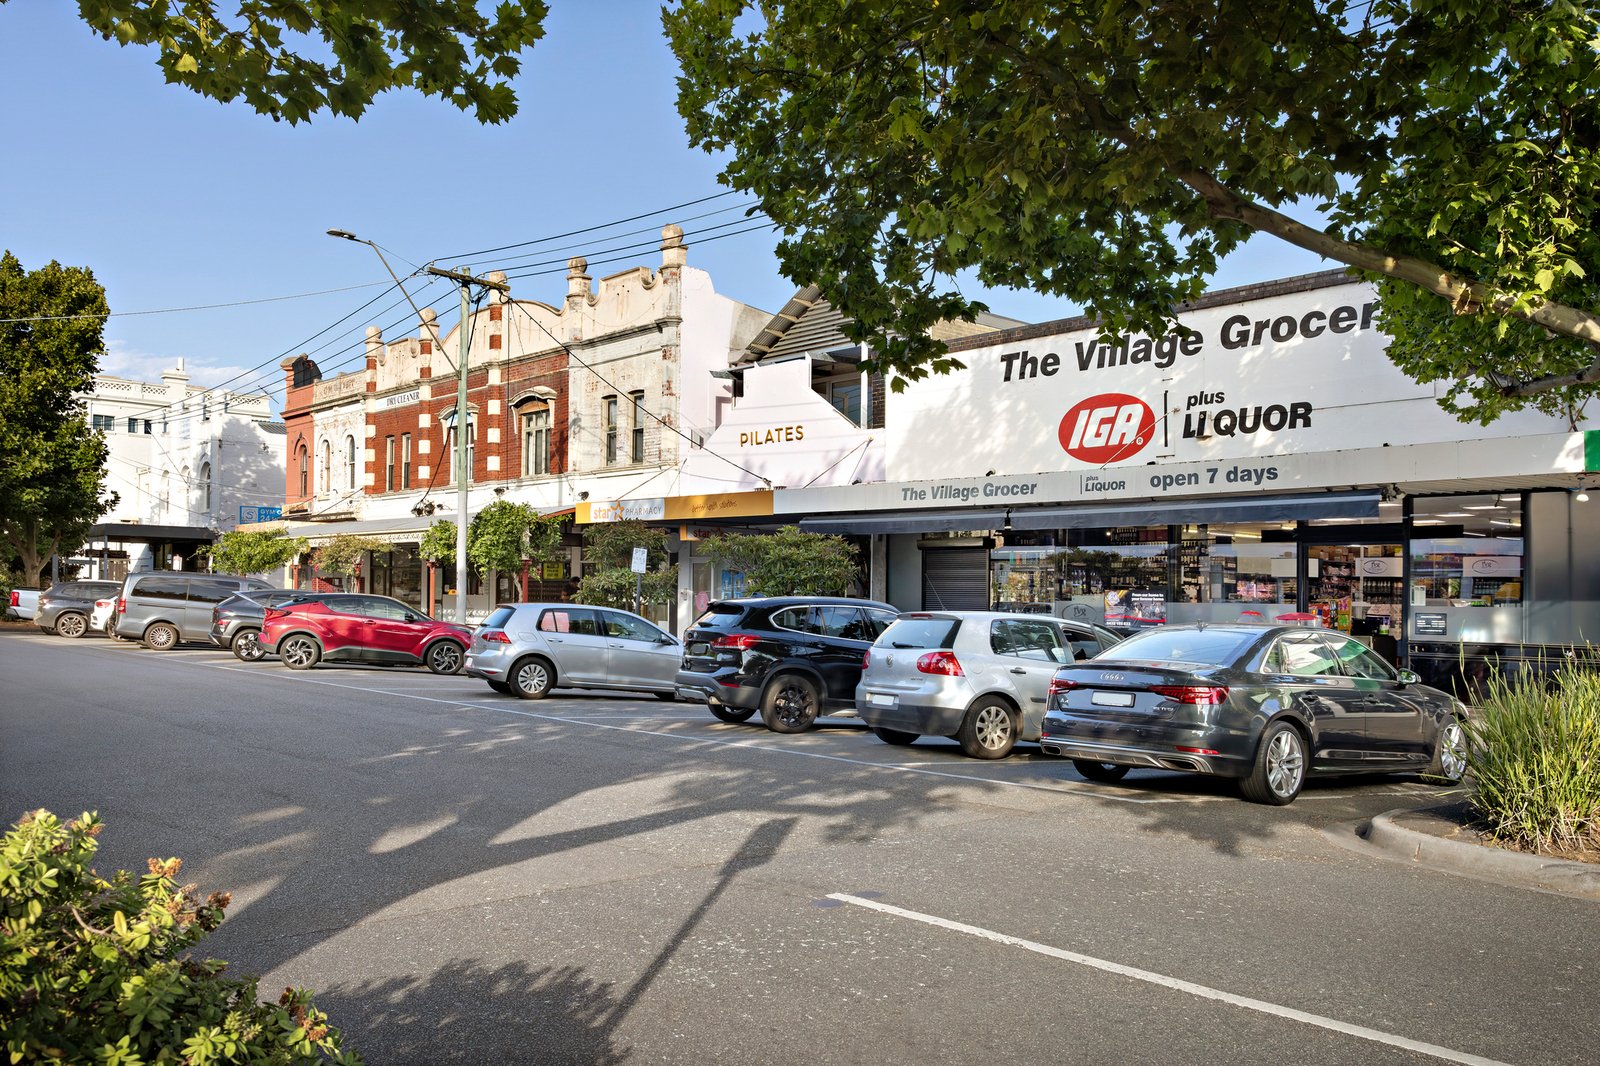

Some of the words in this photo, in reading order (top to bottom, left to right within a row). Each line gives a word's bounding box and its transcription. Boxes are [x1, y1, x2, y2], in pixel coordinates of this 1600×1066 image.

[1001, 350, 1060, 382] The
[1074, 330, 1204, 371] Village
[1220, 302, 1377, 350] Grocer
[386, 397, 397, 407] DRY
[397, 391, 420, 405] CLEANER
[1186, 390, 1225, 411] plus
[1068, 403, 1145, 447] IGA
[1182, 401, 1313, 439] LIQUOR
[740, 425, 804, 447] PILATES
[1085, 475, 1099, 483] plus
[1085, 480, 1126, 492] LIQUOR
[1150, 470, 1201, 490] open
[1206, 467, 1219, 484] 7
[1226, 464, 1279, 485] days
[902, 487, 927, 501] The
[930, 483, 979, 502] Village
[982, 481, 1037, 498] Grocer
[592, 506, 611, 520] star
[625, 506, 662, 517] PHARMACY
